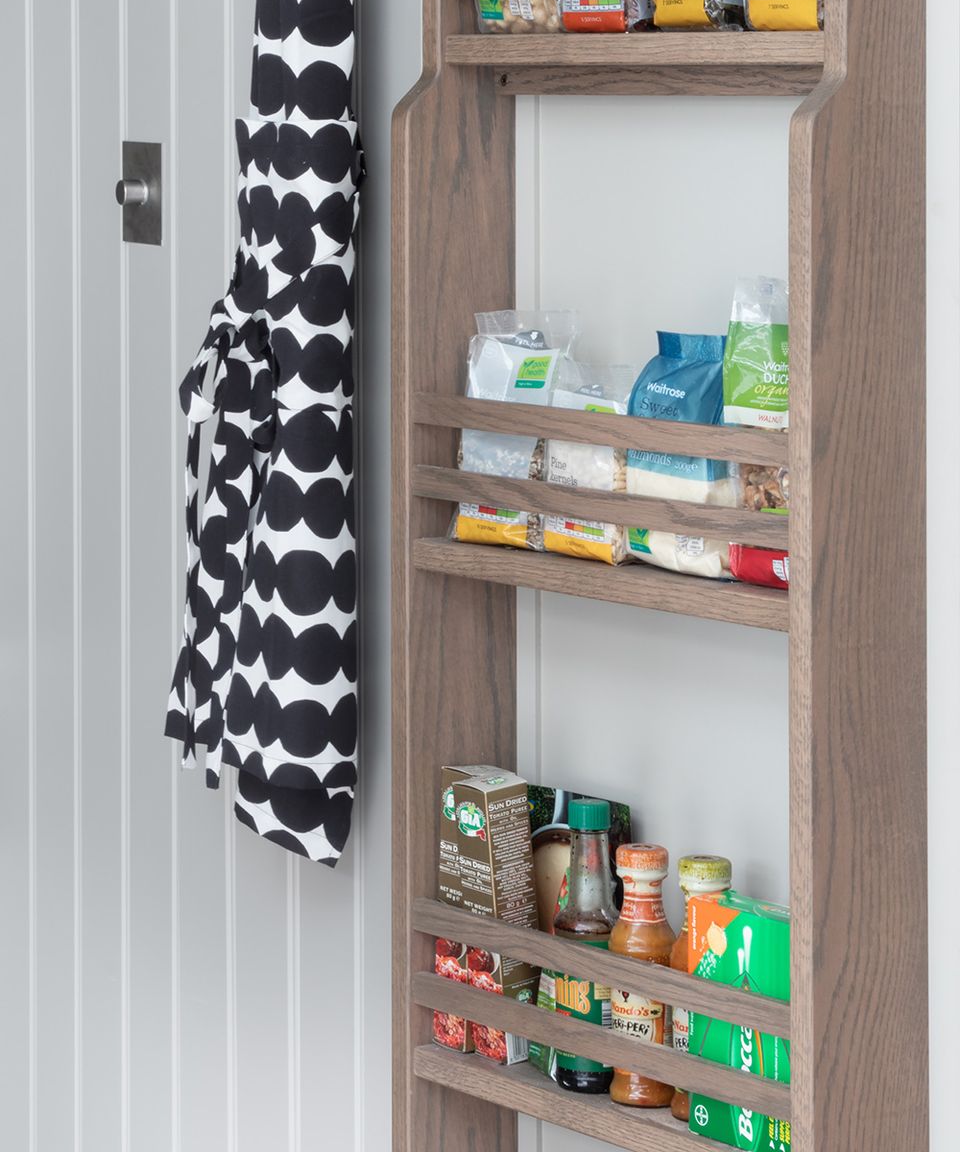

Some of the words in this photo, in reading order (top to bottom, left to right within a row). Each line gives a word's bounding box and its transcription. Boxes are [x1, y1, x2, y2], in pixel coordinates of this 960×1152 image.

[646, 381, 686, 398] Waitrose
[640, 397, 679, 417] Sweet
[488, 802, 505, 812] SUN
[505, 796, 528, 807] DRIED
